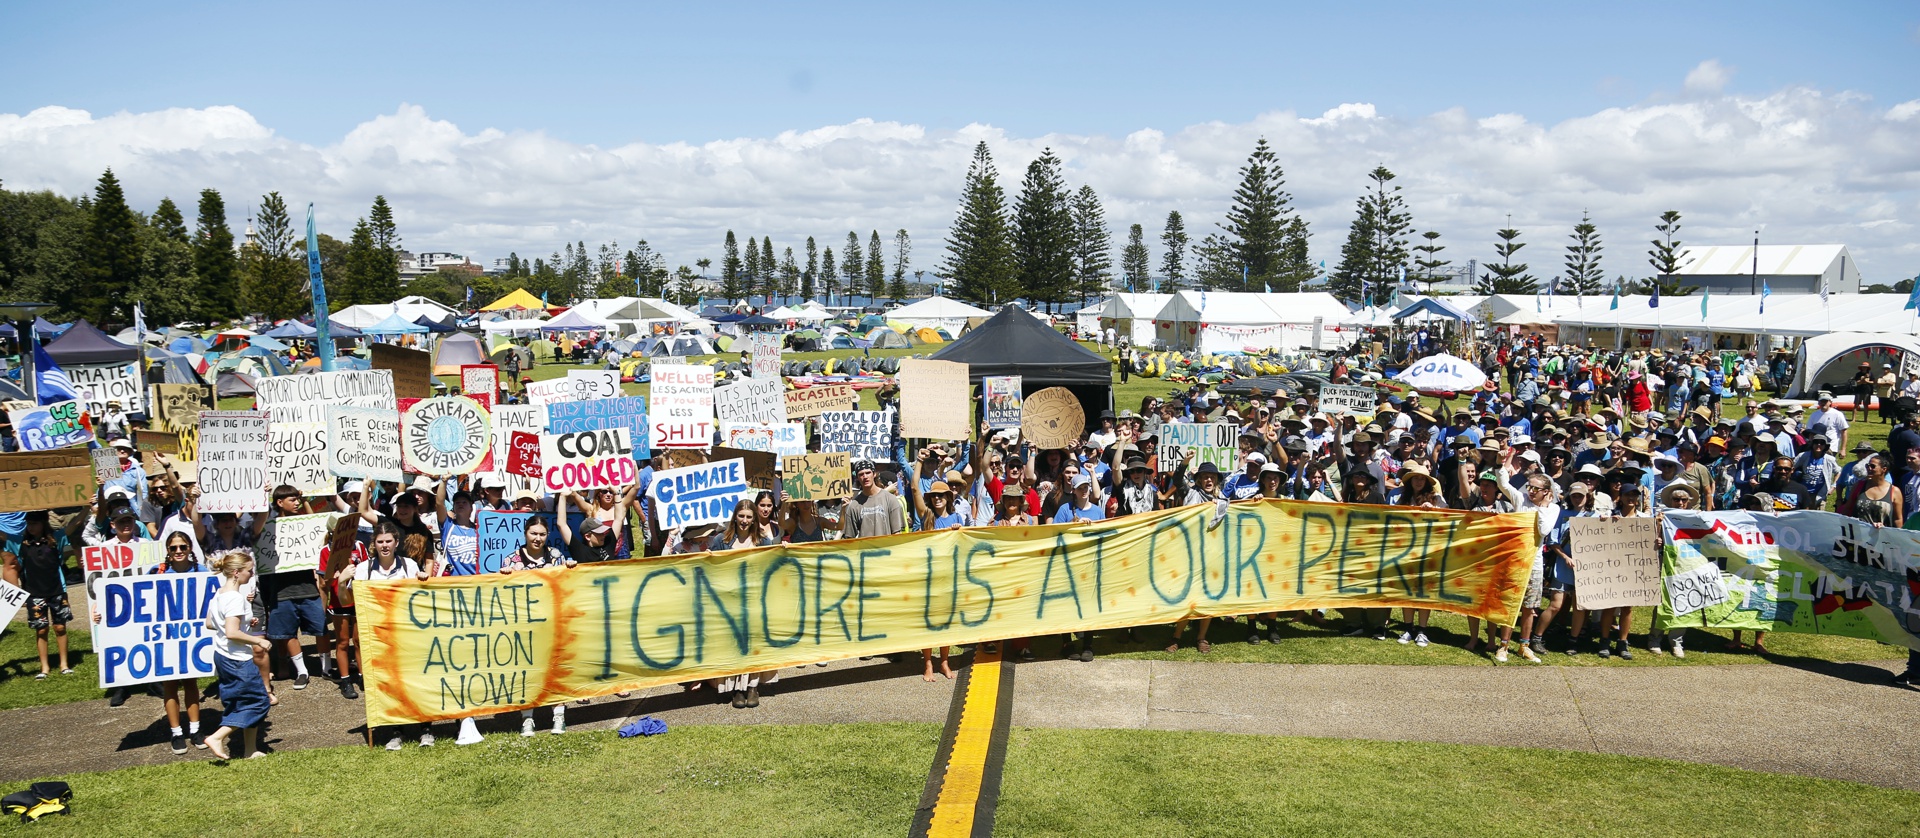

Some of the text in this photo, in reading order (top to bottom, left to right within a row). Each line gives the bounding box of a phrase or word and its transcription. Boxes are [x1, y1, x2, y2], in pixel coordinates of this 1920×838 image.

[757, 332, 777, 343] BE A
[753, 344, 780, 357] FUTURE
[69, 363, 128, 383] IMATE
[697, 373, 713, 384] BE
[1411, 362, 1463, 378] COAL
[256, 378, 296, 409] SUPPORT
[297, 375, 332, 402] COAL
[530, 386, 554, 398] KILL
[575, 373, 615, 398] are 3
[652, 386, 714, 394] LESS ACTIVIST
[747, 381, 776, 397] YOUR
[1323, 387, 1374, 400] FUCK POLITICIANS
[553, 397, 644, 418] HEY HEY HO HO
[652, 396, 712, 406] IF BE
[720, 394, 779, 420] EARTH NOT
[786, 402, 814, 415] ONGER
[1025, 389, 1072, 415] NO KOALAS
[1322, 398, 1373, 409] NOT THE PLANET
[50, 402, 79, 421] WE
[499, 410, 538, 428] HAVE
[669, 408, 693, 417] LESS
[1002, 410, 1020, 418] NEW
[44, 419, 84, 437] WILL
[201, 419, 210, 430] IF
[210, 419, 220, 429] WE
[224, 418, 239, 429] DIG
[242, 418, 250, 428] IT
[338, 415, 358, 428] THE
[822, 423, 863, 433] OF OLD
[1041, 438, 1060, 448] DEAD
[1062, 412, 1085, 446] PLANET
[26, 428, 87, 450] RISE
[241, 433, 255, 443] US
[257, 433, 269, 443] SO
[340, 429, 361, 441] ARE
[656, 422, 710, 443] SHIT
[781, 428, 796, 442] IS
[1162, 424, 1238, 448] PADDLE OUT
[269, 430, 327, 453] STOPPE
[357, 442, 391, 453] NO MORE
[557, 430, 632, 459] COAL
[736, 437, 769, 451] SOLAR
[202, 449, 264, 462] LEAVE IT IN THE
[291, 453, 321, 469] NOT
[1161, 445, 1185, 460] FOR
[520, 463, 543, 476] Sex
[824, 455, 845, 469] MAKE
[97, 470, 119, 480] FOOL
[200, 467, 263, 494] GROUND
[305, 468, 327, 485] WE
[546, 457, 635, 490] COOKED
[655, 461, 739, 503] CLIMATE
[29, 476, 66, 490] Breathe
[4, 484, 88, 509] EAN AIR
[667, 494, 740, 527] ACTION
[279, 521, 305, 534] END
[1572, 520, 1651, 537] What is the
[262, 524, 325, 549] PREDATOR
[483, 537, 508, 551] NEED
[1574, 539, 1650, 554] Government
[85, 546, 134, 572] END
[1832, 536, 1919, 576] STRIK
[1575, 559, 1604, 574] Doing
[1606, 559, 1621, 568] to
[1577, 570, 1659, 587] sition to Re-
[1672, 568, 1719, 595] NO NEW
[105, 576, 222, 628] DENIA
[592, 510, 1473, 682] IGNORE US AT OUR PERIL
[1577, 588, 1618, 604] newable
[1674, 586, 1724, 614] COAL
[408, 583, 547, 630] CLIMATE
[144, 621, 204, 642] IS NOT
[105, 636, 213, 684] POLIC
[424, 630, 534, 674] ACTION
[440, 670, 527, 711] NOW!
